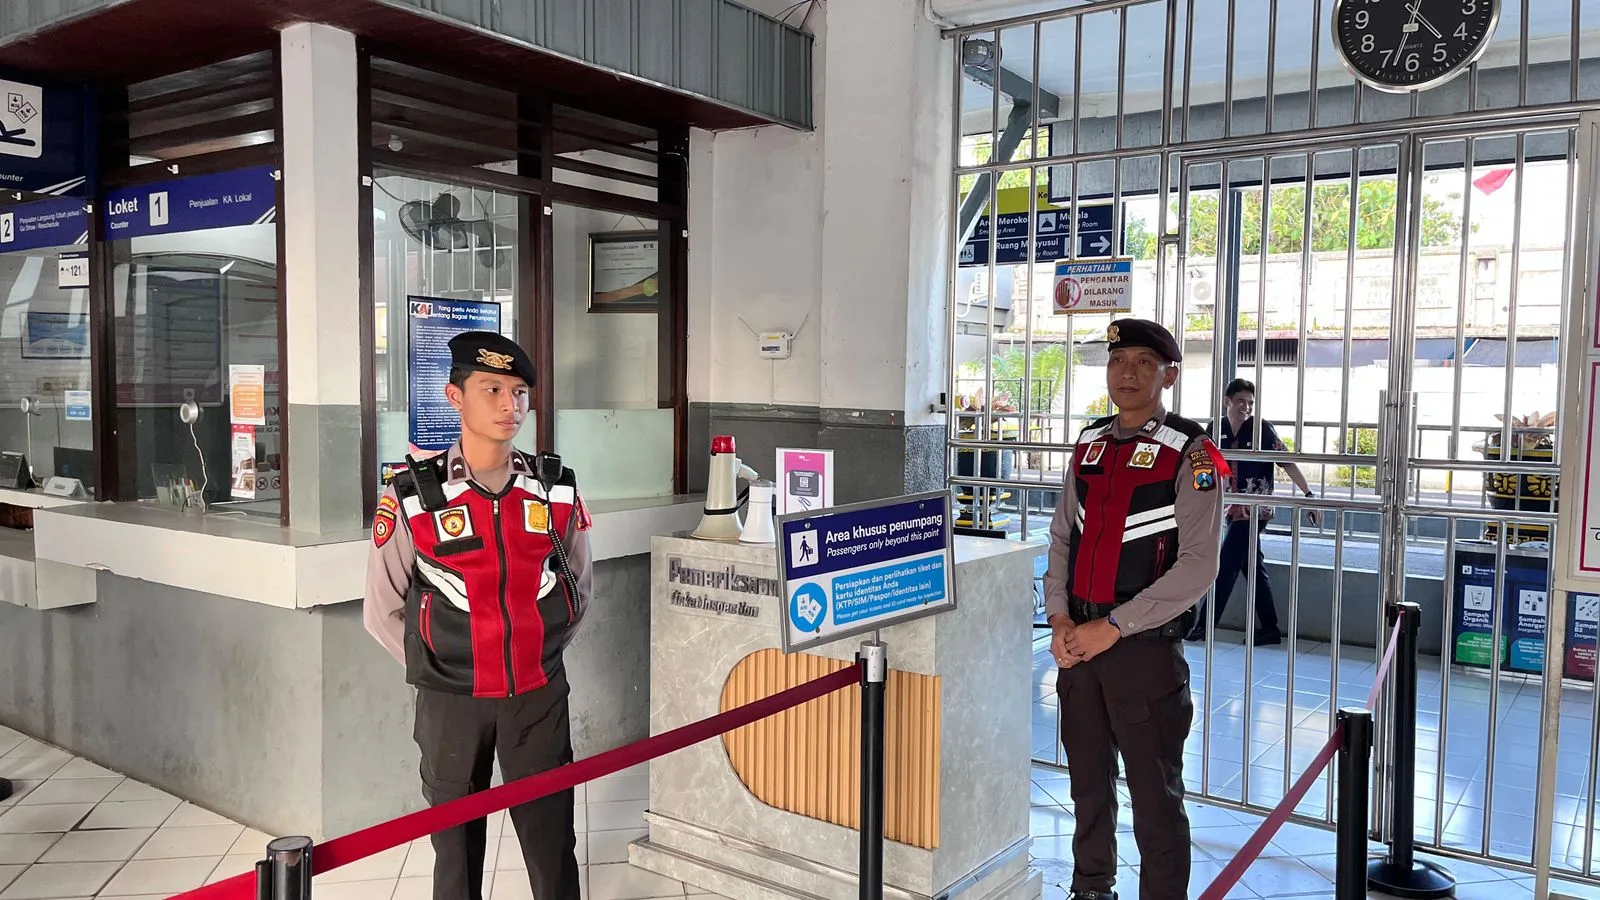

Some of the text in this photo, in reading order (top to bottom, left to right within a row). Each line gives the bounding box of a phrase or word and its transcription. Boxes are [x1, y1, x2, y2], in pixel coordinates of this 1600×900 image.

[1355, 10, 1370, 30] 9
[1453, 22, 1468, 41] 4
[1360, 34, 1375, 53] 8
[1432, 43, 1447, 62] 5
[1379, 50, 1393, 69] 7
[1405, 52, 1420, 72] 6
[108, 197, 139, 216] Loket
[154, 196, 162, 218] 1
[189, 192, 252, 209] Penjualan KA Lokal
[4, 218, 11, 237] 2
[110, 220, 129, 230] Counter
[996, 242, 1019, 250] Ruang
[1067, 264, 1112, 273] PERHATIAN
[1081, 275, 1129, 284] PENGANTAR
[1084, 287, 1124, 296] DILARANG
[1089, 299, 1118, 307] MASUK
[451, 313, 468, 321] Bagasi
[468, 314, 497, 323] Penumpang
[825, 514, 943, 544] Area khusus penumpang
[826, 528, 940, 558] Passengers only beyond this point
[835, 561, 942, 591] Persiapkan dan perlihatkan tiket dan
[918, 580, 932, 591] lain)
[835, 580, 899, 600] kartu identitas Anda
[1575, 621, 1598, 631] Sampa
